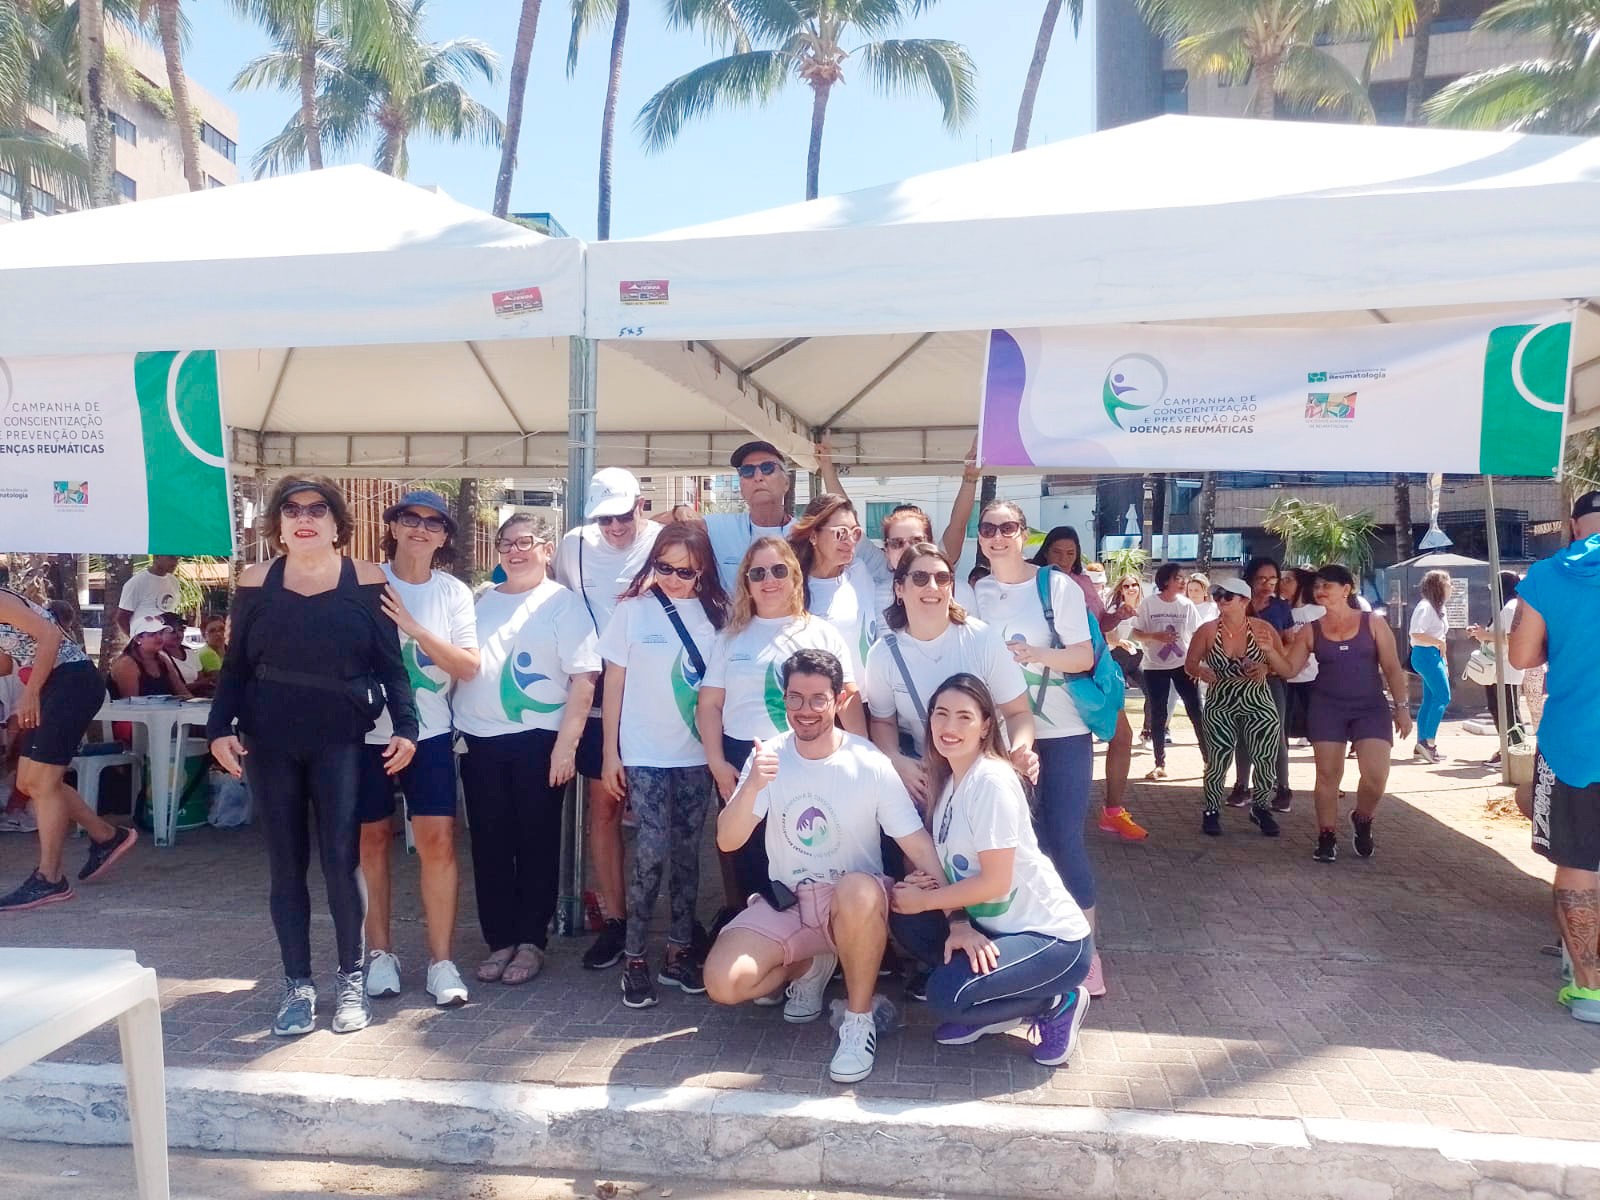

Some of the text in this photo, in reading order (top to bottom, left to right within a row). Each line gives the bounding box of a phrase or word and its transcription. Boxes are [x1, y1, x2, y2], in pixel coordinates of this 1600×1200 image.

[12, 402, 101, 412] CAMPANHA DE
[1163, 395, 1257, 406] CAMPANHA DE
[1153, 402, 1257, 416] CONSCIENTIZAÇÃO
[3, 414, 103, 428] CONSCIENTIZAÇÃO
[1154, 413, 1228, 425] PREVENÇÃO
[1232, 414, 1256, 423] DAS
[6, 428, 78, 443] PREVENÇÃO
[81, 430, 104, 440] DAS
[1130, 423, 1254, 436] DOENÇAS REUMÁTICAS
[37, 441, 105, 454] REUMÁTICAS
